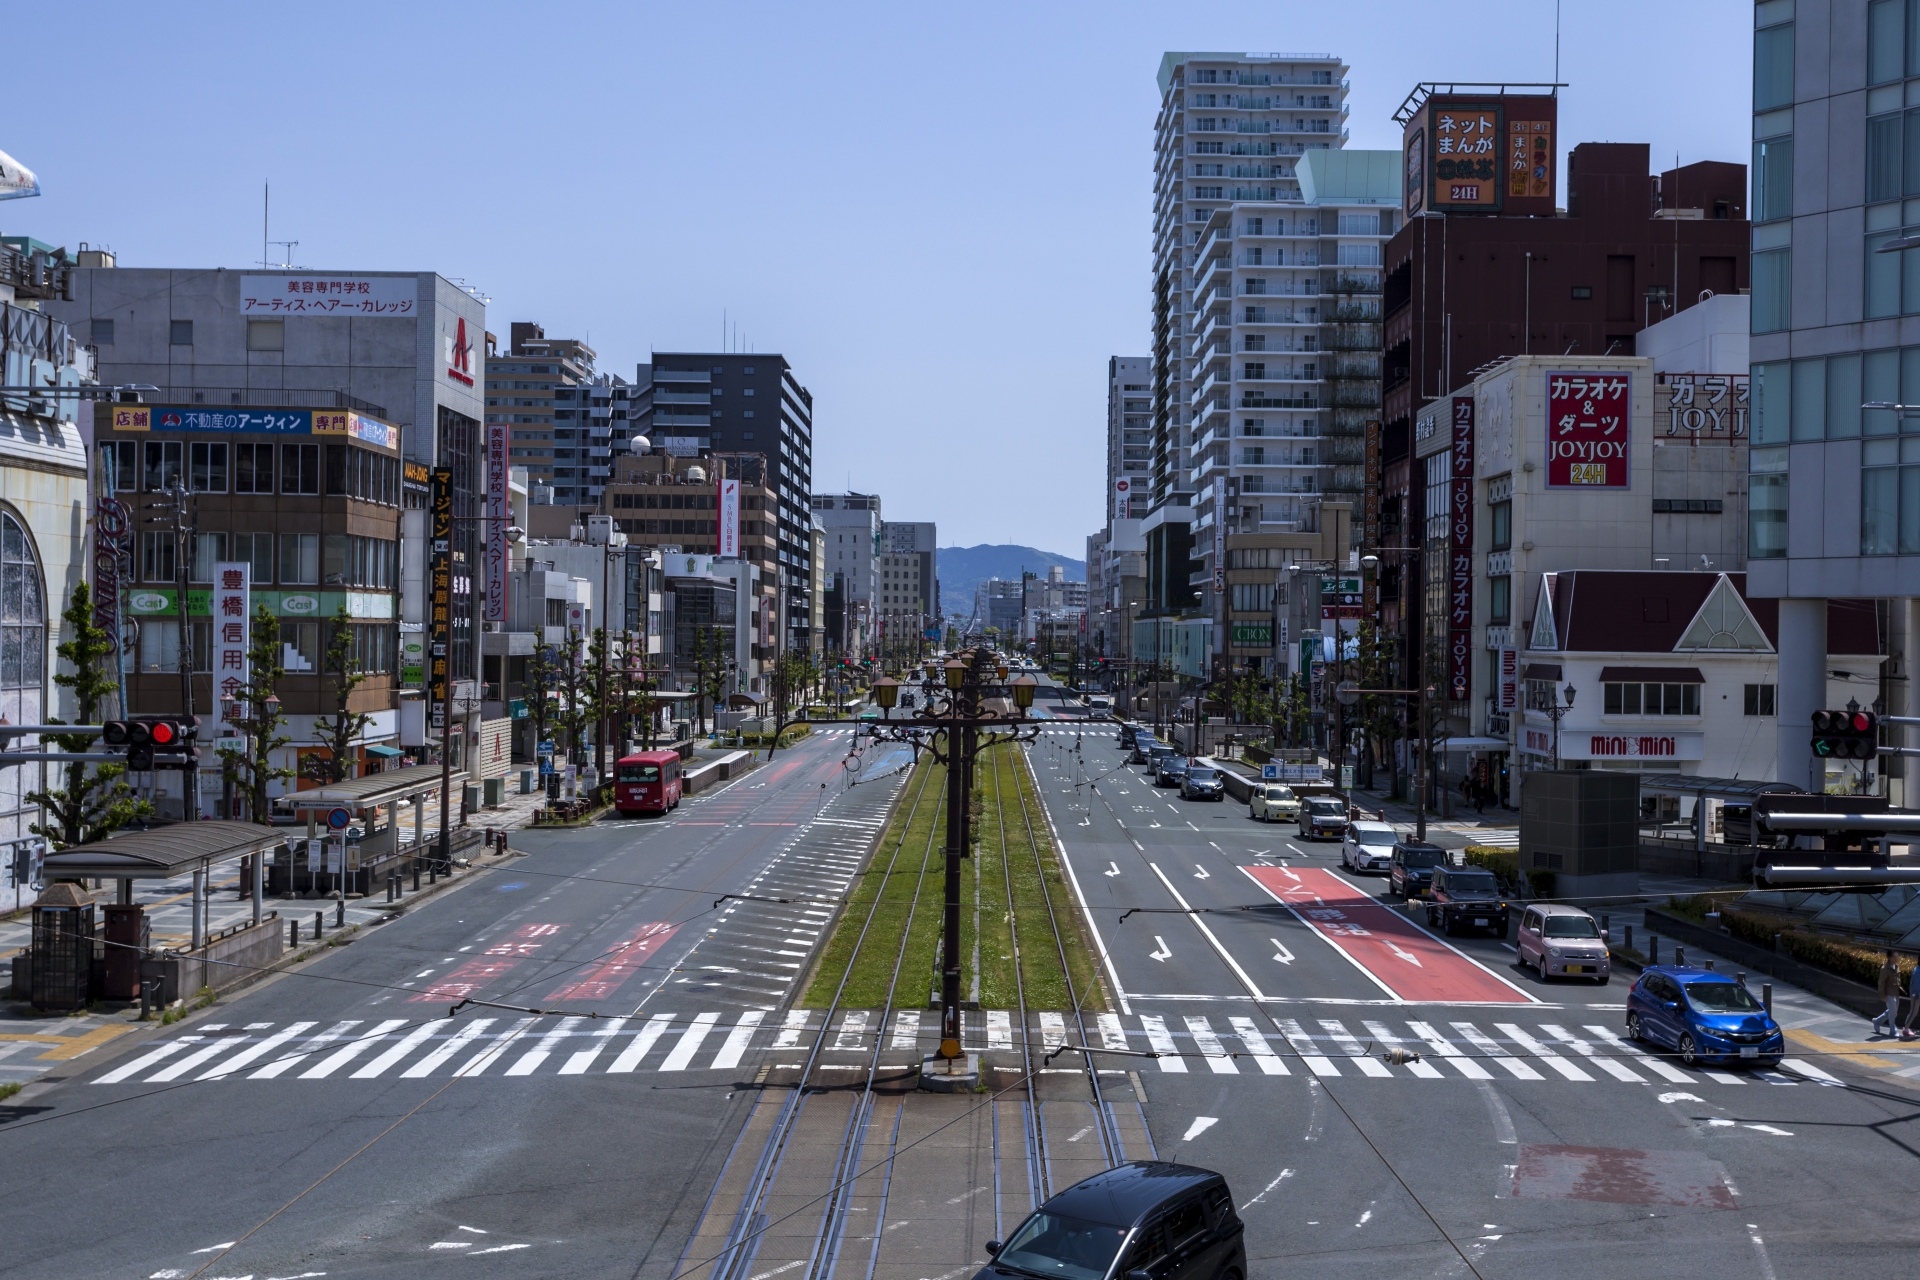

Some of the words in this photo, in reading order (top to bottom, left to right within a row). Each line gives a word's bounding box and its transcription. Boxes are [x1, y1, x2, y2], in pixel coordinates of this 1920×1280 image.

[1438, 115, 1493, 133] ネット
[1513, 122, 1528, 131] 3F
[1533, 123, 1548, 131] 4F
[1438, 136, 1494, 154] まんが
[1533, 136, 1547, 194] カラオケ
[1451, 186, 1478, 199] 24H
[287, 281, 371, 294] 美容専門学校
[244, 298, 413, 313] アーティス・ヘアー・カレッジ
[1551, 377, 1627, 400] カラオケ
[1583, 400, 1595, 414] &
[115, 411, 149, 428] 店舗
[185, 413, 301, 431] 不動産のアーウィン
[315, 415, 346, 432] 専門
[1558, 414, 1619, 435] ダーツ
[1455, 402, 1471, 472] カラオケ
[490, 428, 503, 493] 美容専門学校
[1367, 422, 1377, 482] インターネット
[1550, 441, 1627, 462] JOYJOY
[1571, 464, 1605, 484] 24H
[436, 471, 451, 537] マージャン
[1455, 482, 1469, 545] JOYJOY
[1366, 488, 1376, 546] まんが喫茶
[1452, 554, 1470, 624] カラオケ
[136, 596, 163, 609] Cast
[286, 600, 313, 610] Cast
[1503, 650, 1516, 675] mini
[1503, 685, 1516, 708] mini
[1590, 735, 1627, 756] mini
[1639, 735, 1675, 756] mini
